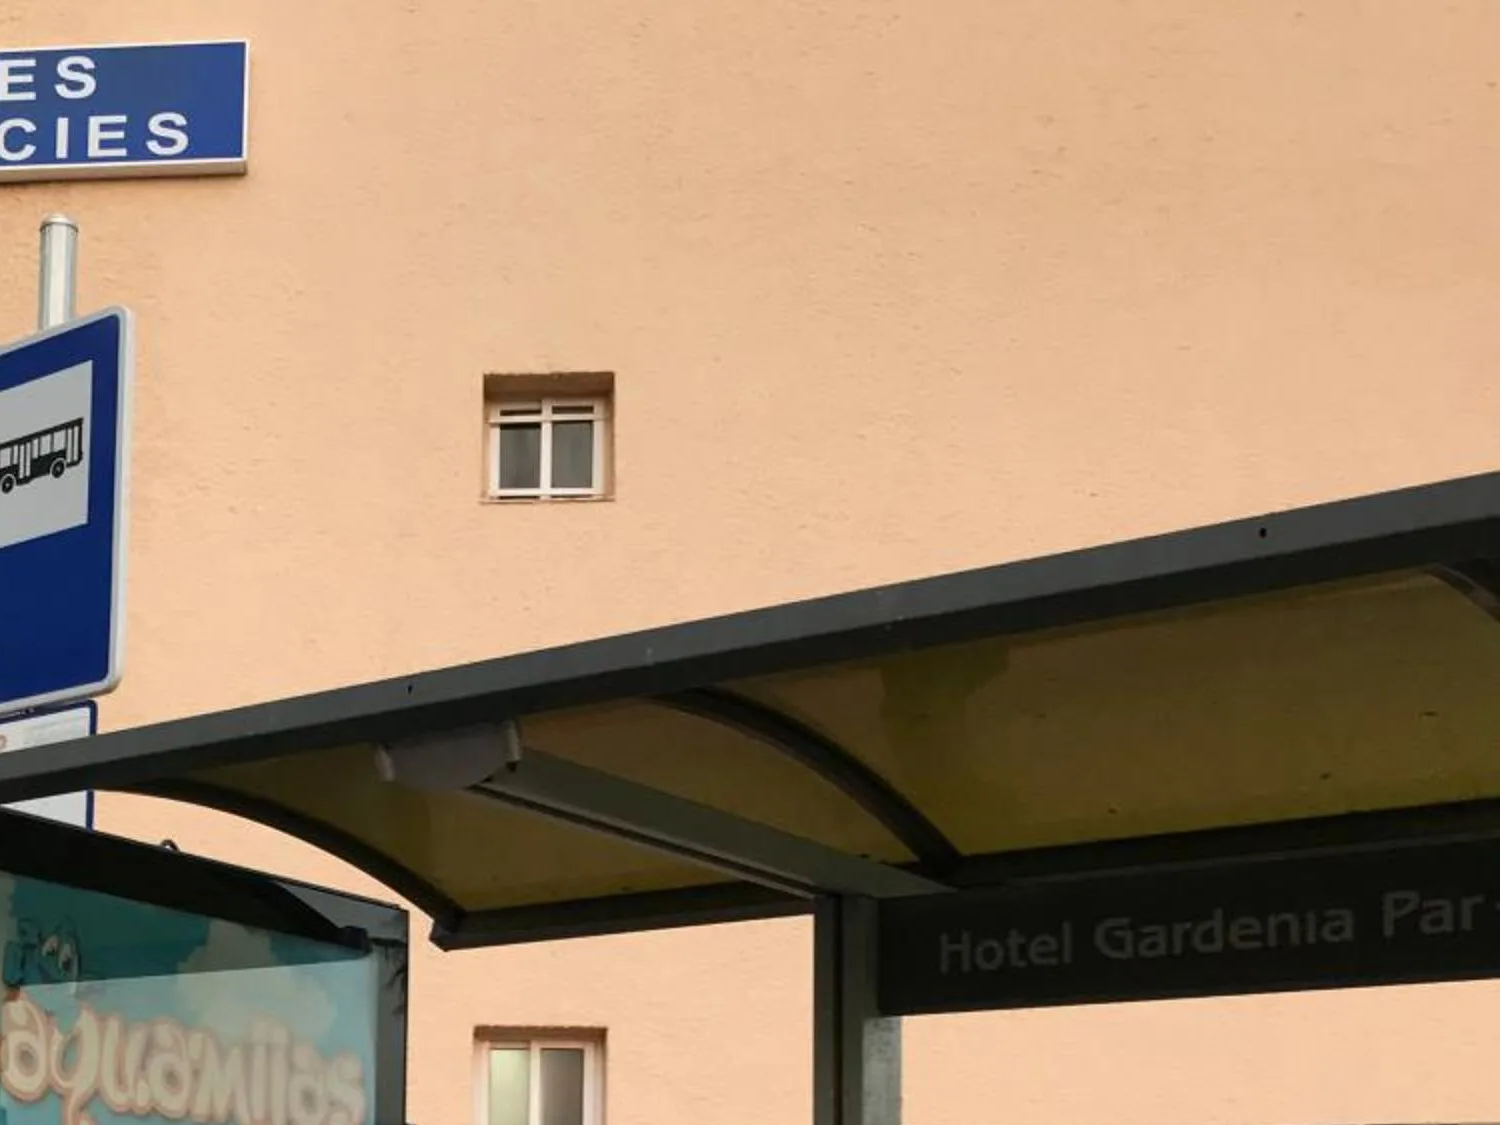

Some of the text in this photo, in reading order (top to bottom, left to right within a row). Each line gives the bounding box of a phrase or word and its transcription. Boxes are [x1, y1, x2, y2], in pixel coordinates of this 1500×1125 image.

[938, 889, 1500, 975] Hotel Gardenia Par
